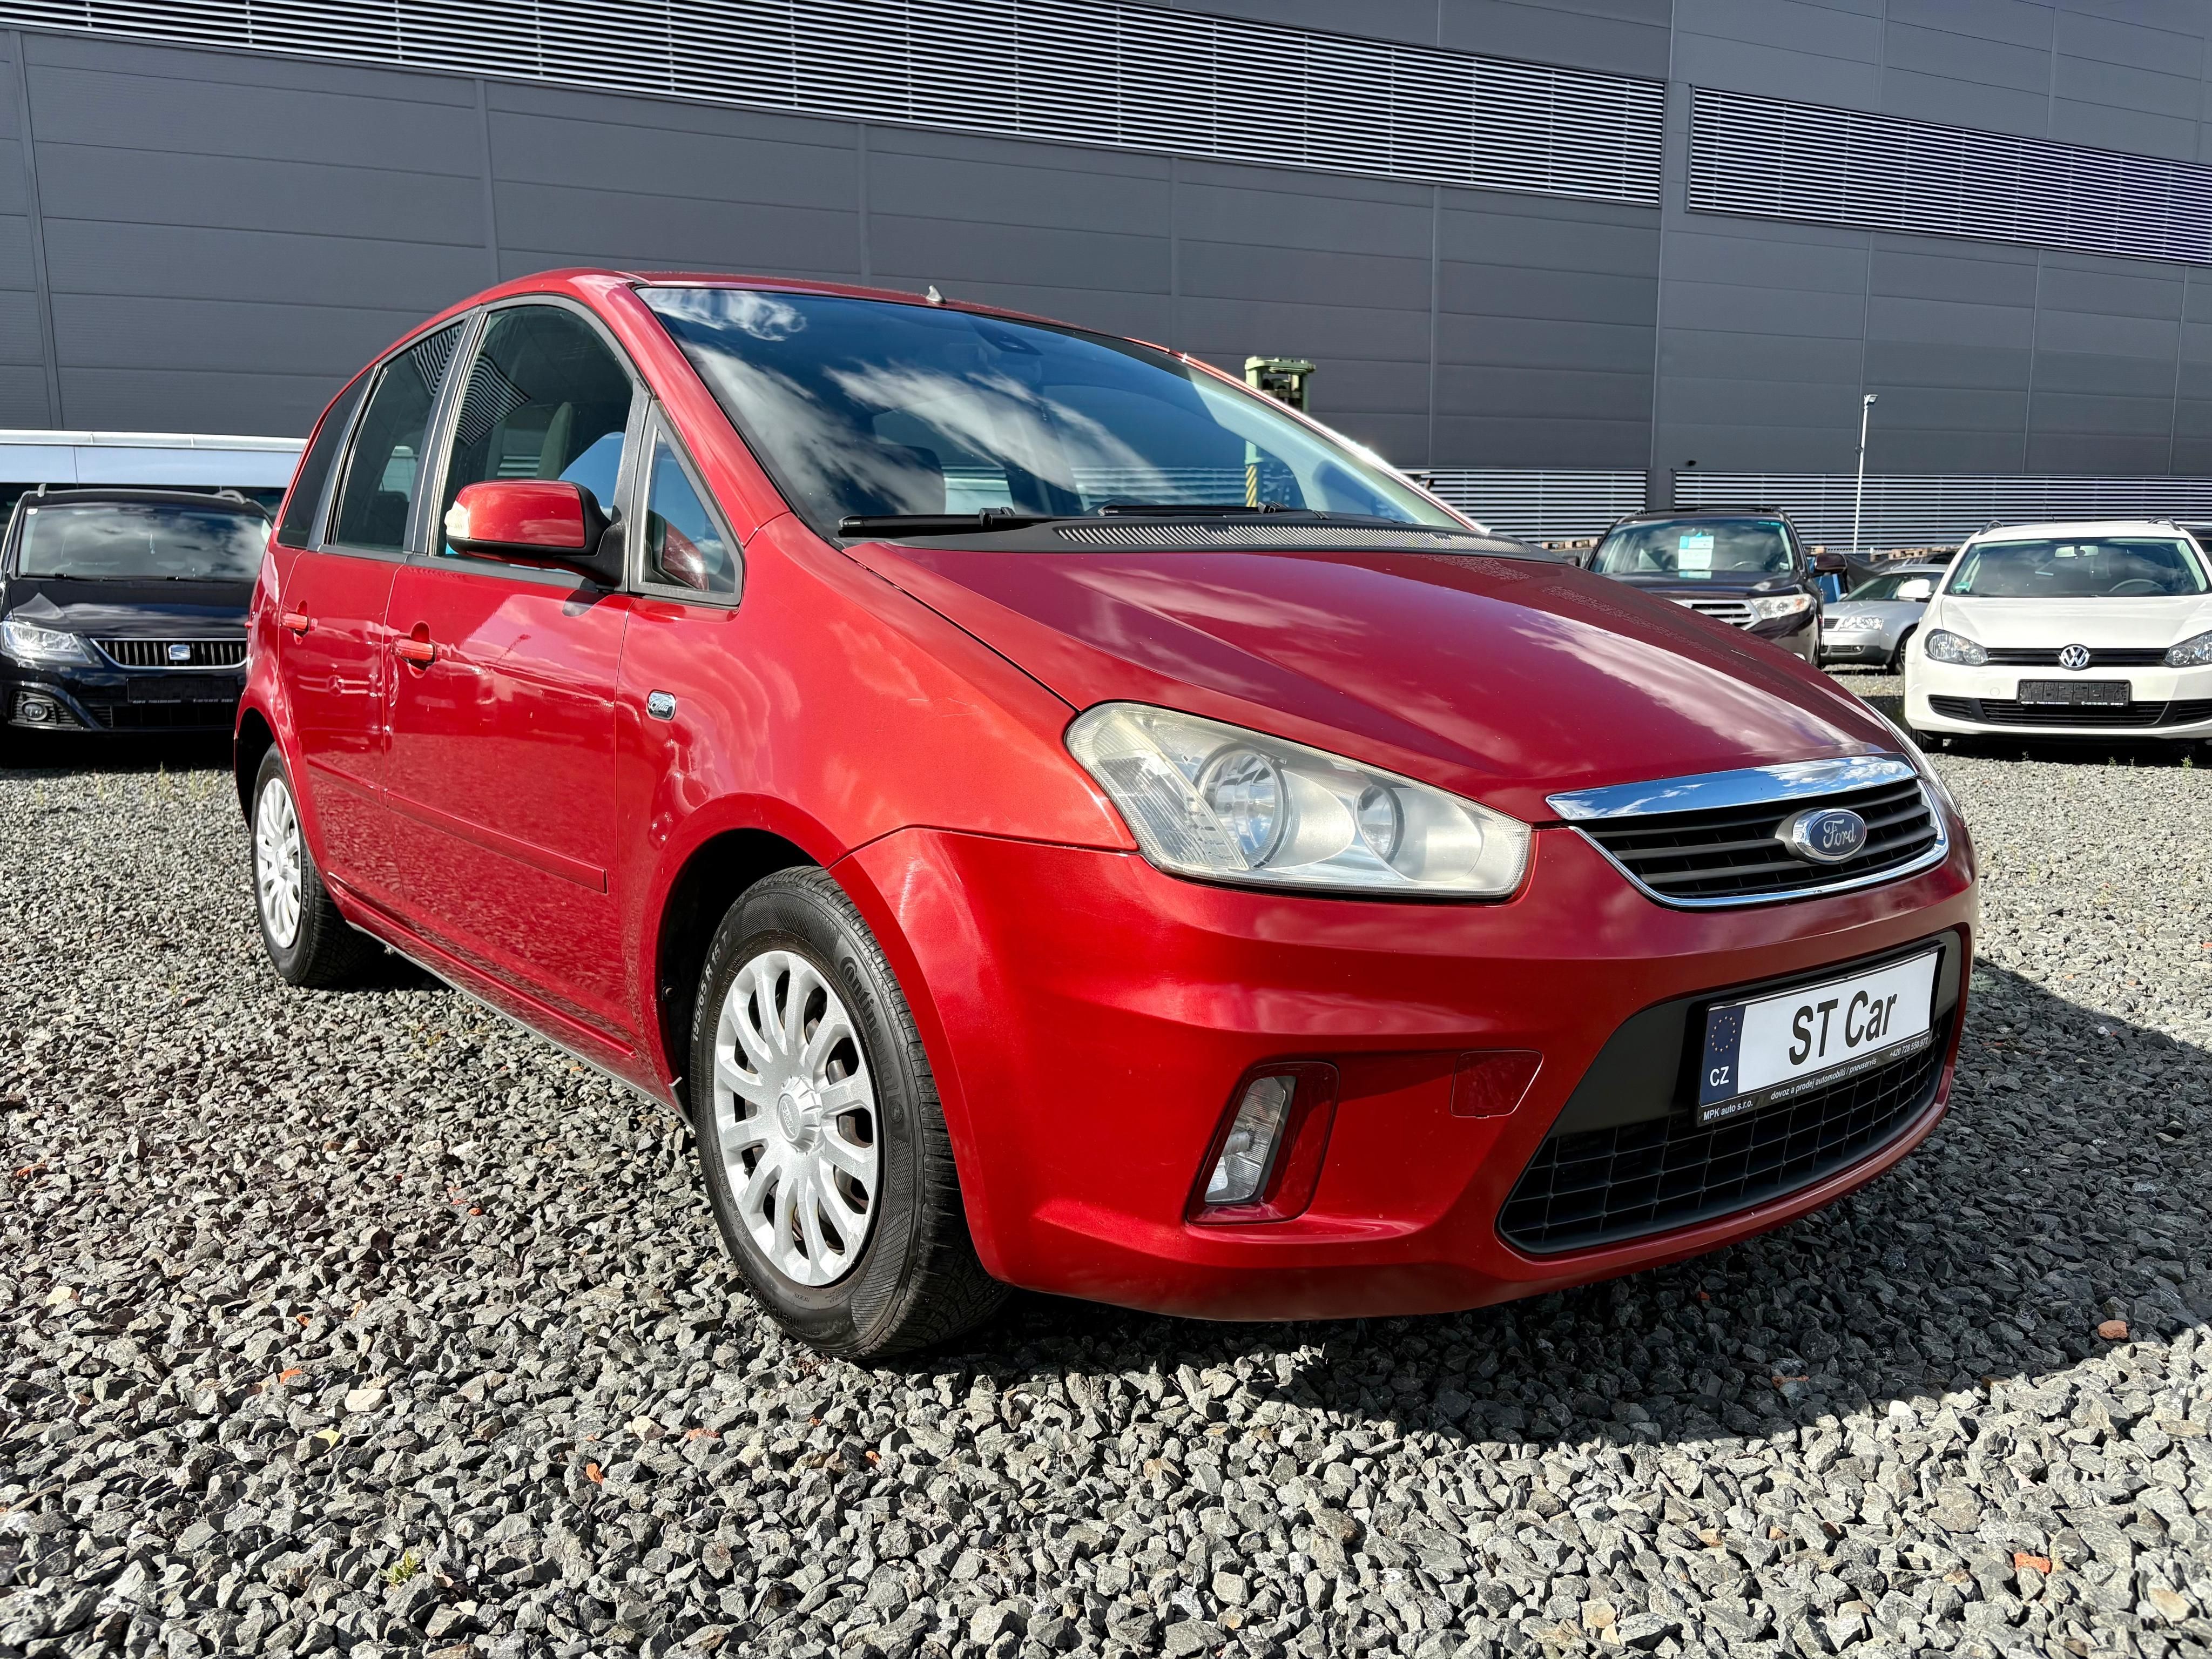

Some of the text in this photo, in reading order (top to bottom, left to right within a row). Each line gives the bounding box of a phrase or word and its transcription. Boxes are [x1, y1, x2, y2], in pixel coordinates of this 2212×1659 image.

[1823, 819, 1856, 848] Ford
[691, 979, 707, 1042] 195/65
[705, 963, 713, 981] R
[711, 943, 721, 966] 15
[839, 956, 901, 1098] Continental
[1789, 990, 1898, 1065] ST Car
[1889, 1036, 1929, 1057] +420 728 550 977
[1710, 1065, 1730, 1087] CZ
[1771, 1088, 1790, 1101] dovoz
[1796, 1078, 1815, 1094] prodej
[1849, 1057, 1877, 1076] pneuservis
[1703, 1100, 1754, 1121] MPK auto s.r.o.
